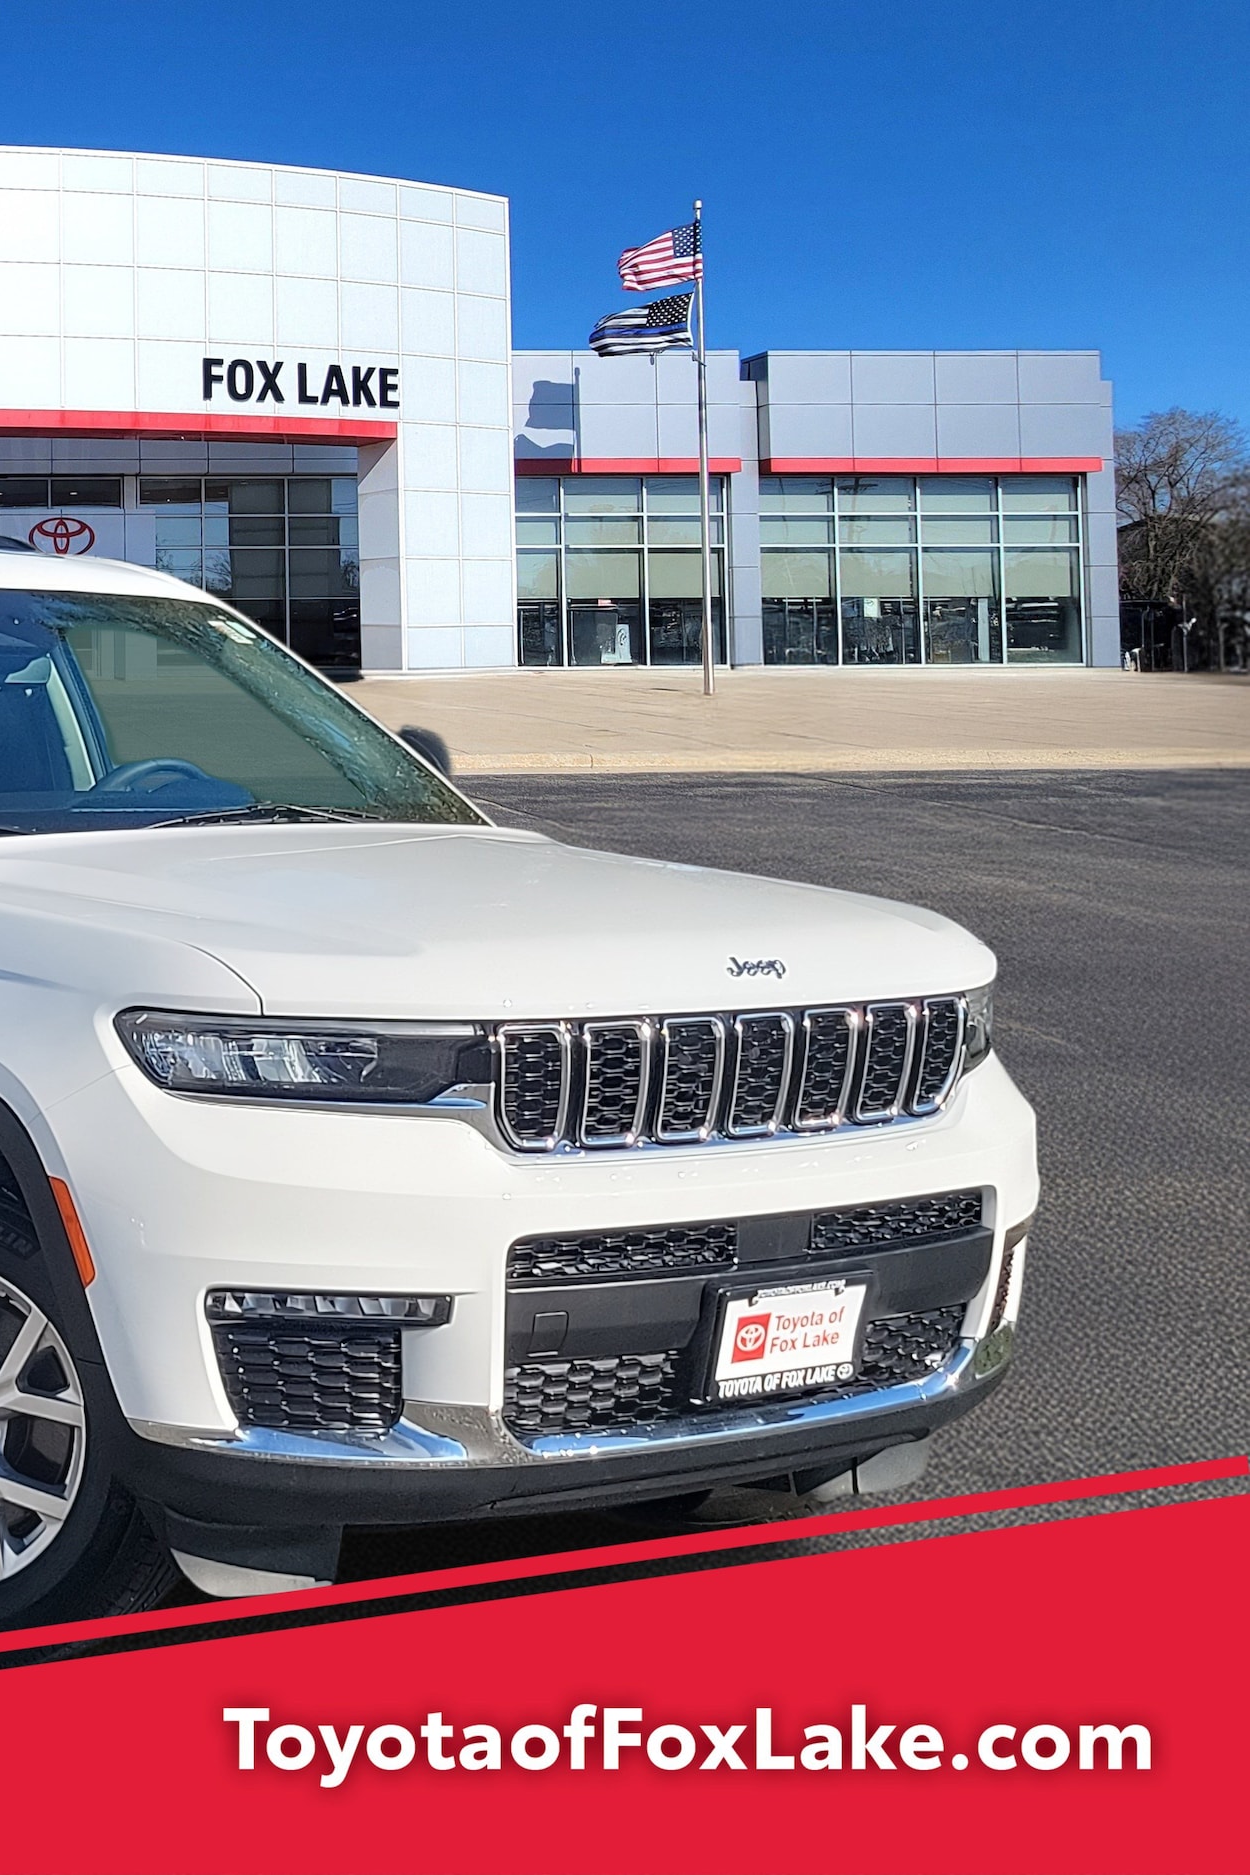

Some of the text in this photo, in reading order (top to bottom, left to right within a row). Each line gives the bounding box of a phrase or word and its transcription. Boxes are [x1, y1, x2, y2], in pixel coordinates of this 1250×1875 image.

[202, 357, 400, 408] FOX LAKE
[726, 956, 786, 979] Jeep
[774, 1306, 846, 1334] Toyota of
[769, 1329, 840, 1354] Fox Lake
[718, 1364, 837, 1398] TOYOTA OF FOX LAKE
